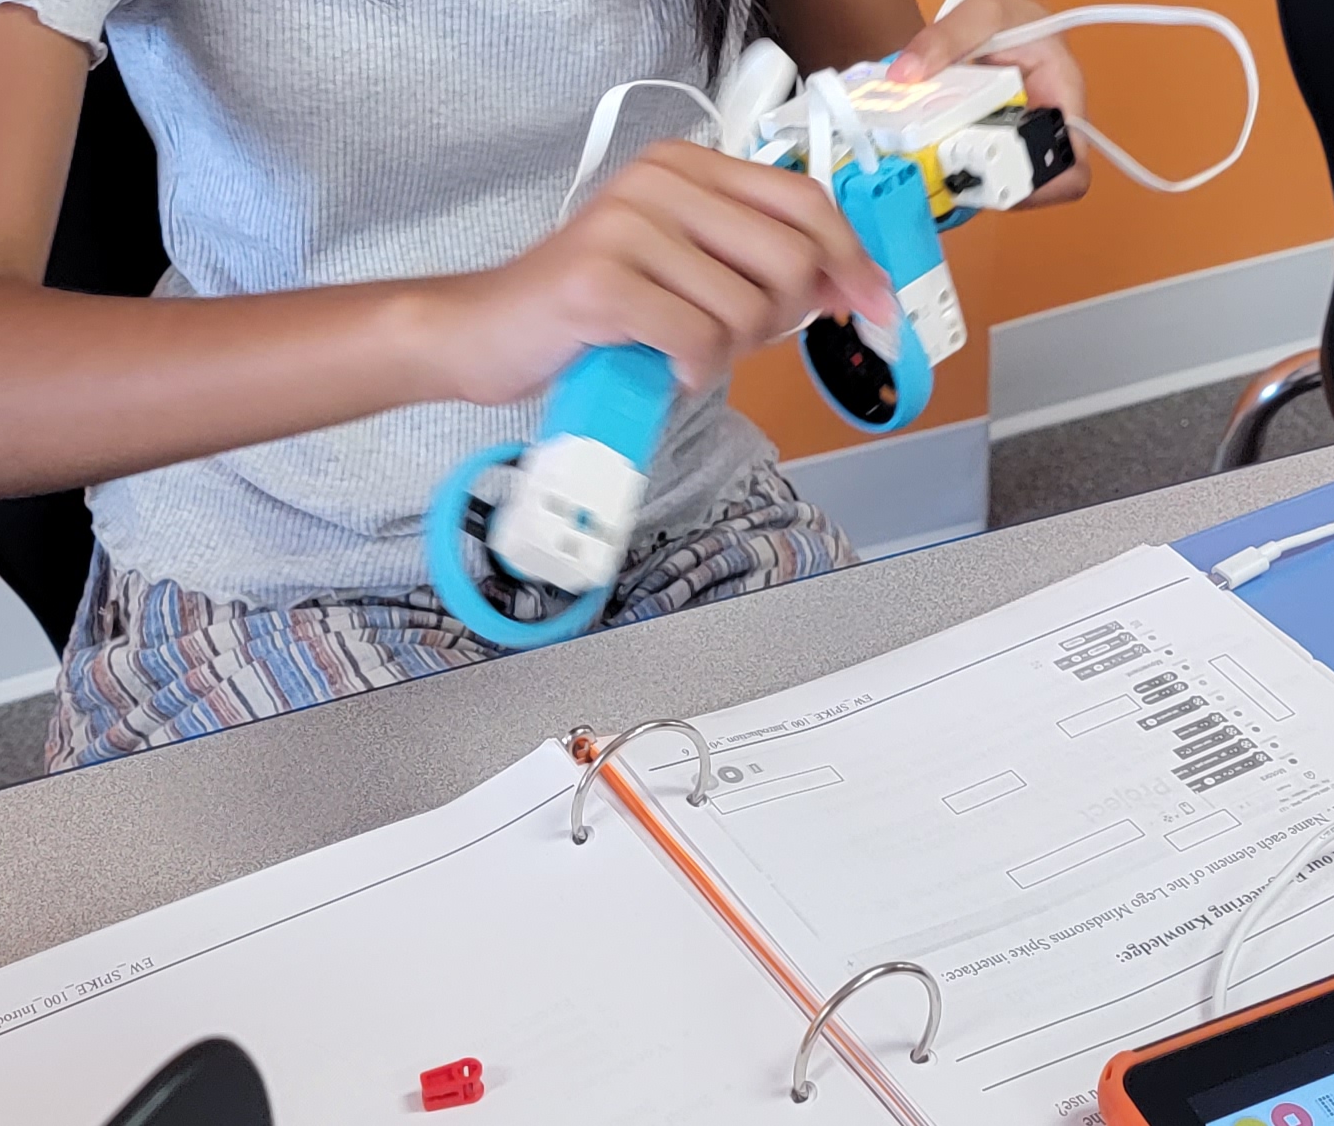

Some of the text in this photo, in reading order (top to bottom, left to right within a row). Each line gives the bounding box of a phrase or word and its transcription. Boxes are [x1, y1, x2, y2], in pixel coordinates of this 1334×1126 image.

[681, 694, 873, 756] EW_SPIKE_100_Introduction_v0 6
[1288, 814, 1329, 834] Name
[1256, 832, 1287, 850] each
[1205, 846, 1256, 874] element
[1167, 878, 1190, 891] the
[1189, 870, 1205, 884] of
[1131, 888, 1169, 907] Lego
[1049, 904, 1132, 943] Mindstorms
[1009, 939, 1051, 957] Spike
[1116, 914, 1213, 962] Knowledge:
[941, 953, 1010, 982] interface:
[1055, 1095, 1089, 1116] use?
